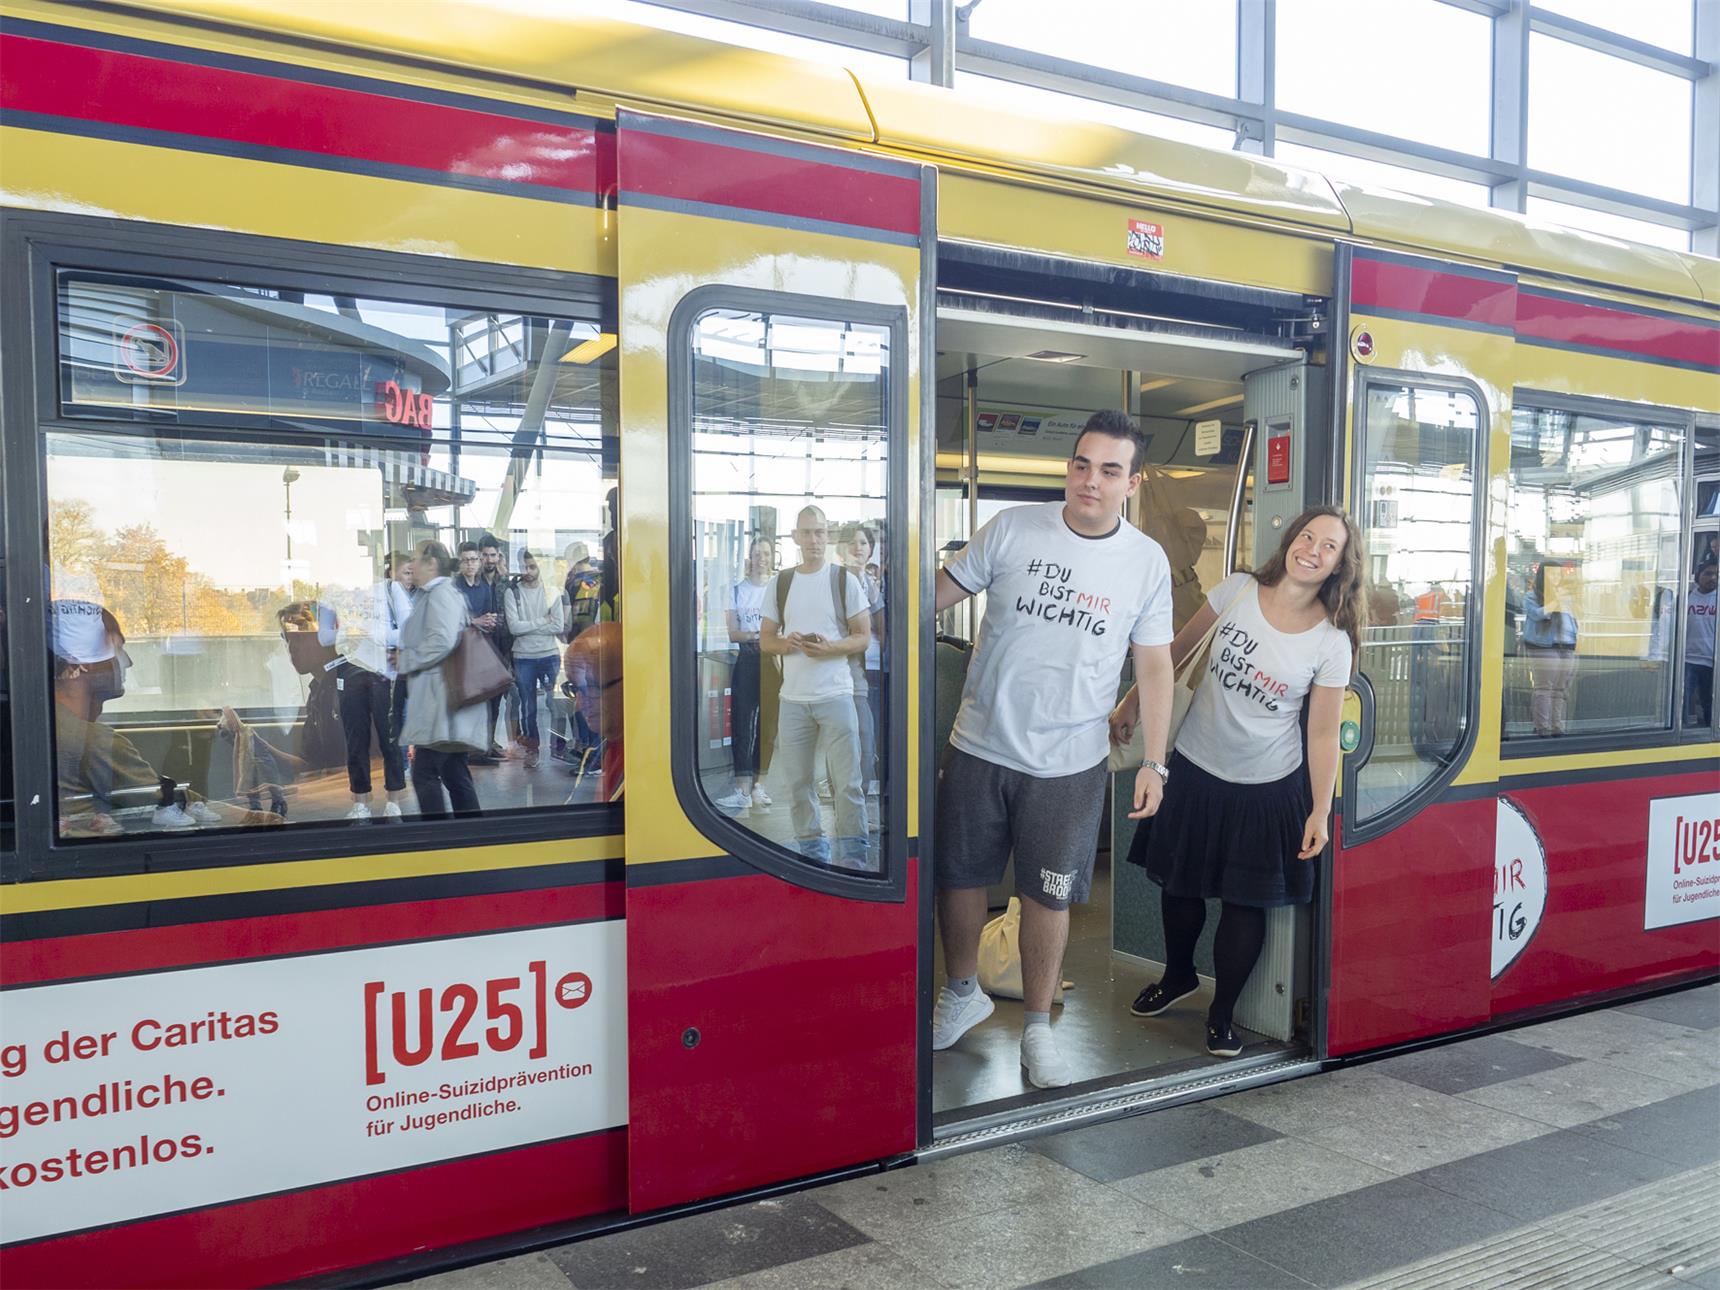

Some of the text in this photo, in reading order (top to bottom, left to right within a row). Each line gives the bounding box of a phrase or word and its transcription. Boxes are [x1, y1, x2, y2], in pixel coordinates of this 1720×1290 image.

[1027, 559, 1072, 583] #DU
[1016, 596, 1106, 636] WICHTIG
[1039, 581, 1111, 615] BIST MIR
[1219, 621, 1259, 655] #DU
[1210, 658, 1279, 711] WICHTIG
[1221, 648, 1289, 697] BIST MIR
[44, 1030, 117, 1064] der
[131, 1011, 279, 1051] Caritas
[0, 1074, 225, 1138] gendliche.
[366, 1063, 592, 1112] Online-Suizidprävention
[366, 1100, 521, 1137] für Jugendliche.
